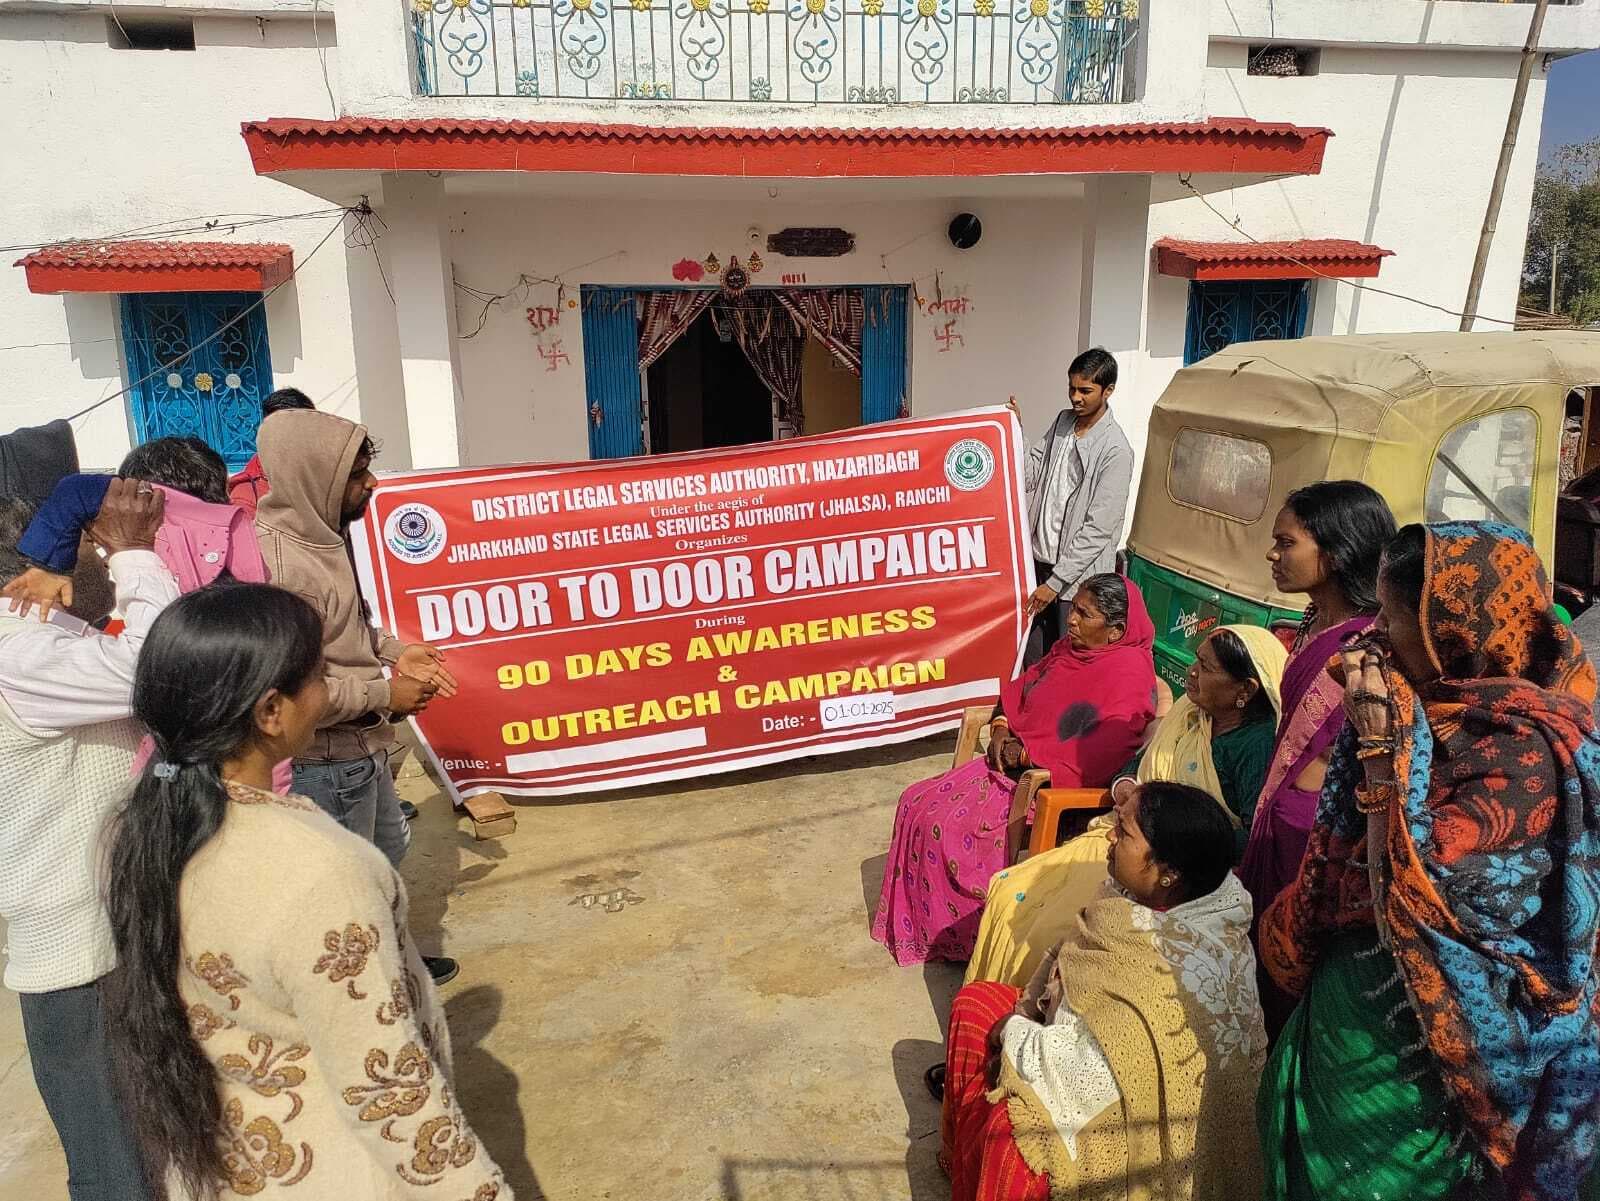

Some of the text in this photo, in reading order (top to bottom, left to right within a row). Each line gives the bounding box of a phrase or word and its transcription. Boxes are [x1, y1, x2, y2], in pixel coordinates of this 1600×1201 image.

[471, 490, 561, 522] DISTRICT
[563, 484, 618, 511] LEGAL
[620, 473, 707, 504] SERVICES
[710, 462, 811, 493] AUTHORITY,
[812, 450, 920, 482] HAZARIBAGH
[650, 494, 765, 518] Under the aegis of
[448, 485, 952, 564] JHARKHAND STATE LEGAL SERVICES AUTHORITY (JHALSA), RANCHI
[675, 532, 748, 552] Organizes
[416, 524, 988, 641] DOOR TO DOOR CAMPAIGN
[497, 605, 937, 690] 90 DAYS AWARENESS
[695, 614, 746, 630] During
[501, 658, 946, 745] OUTREACH CAMPAIGN
[716, 665, 739, 683] &
